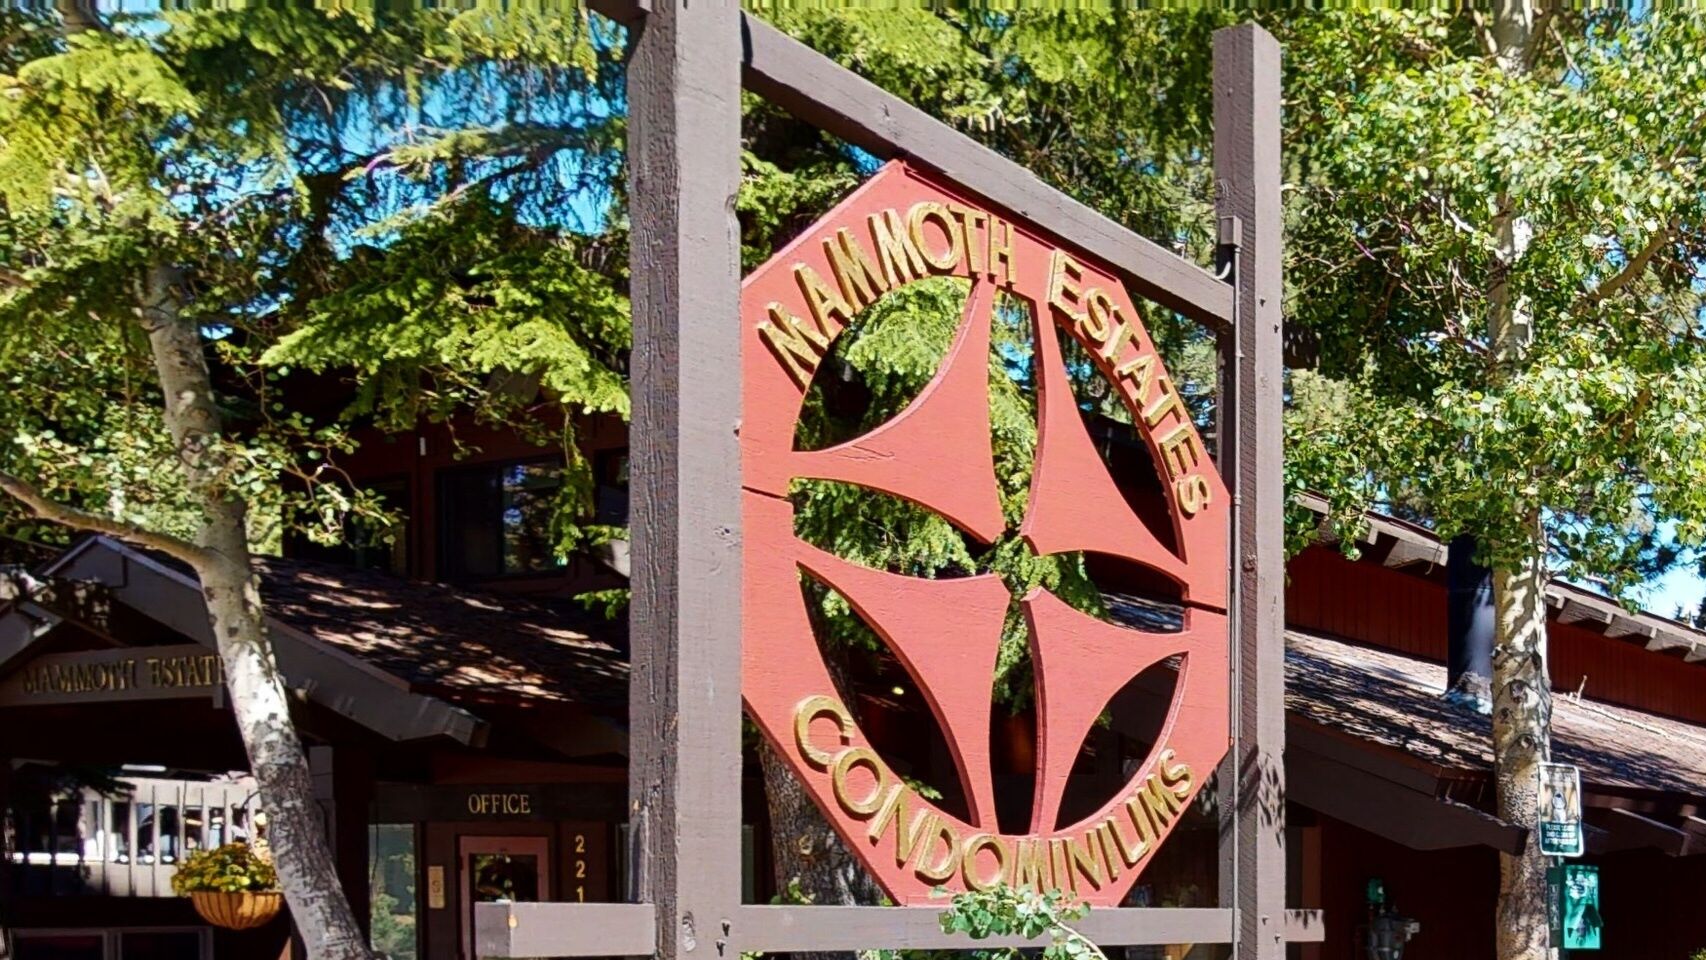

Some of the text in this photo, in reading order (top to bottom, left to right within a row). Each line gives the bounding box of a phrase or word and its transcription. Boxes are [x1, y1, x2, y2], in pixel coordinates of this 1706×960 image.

[757, 201, 1212, 519] MAMMOTH ESTATES
[22, 660, 138, 694] MAMMOTH
[468, 793, 531, 814] OFFICE
[793, 694, 1195, 895] CONDOMINIUMS
